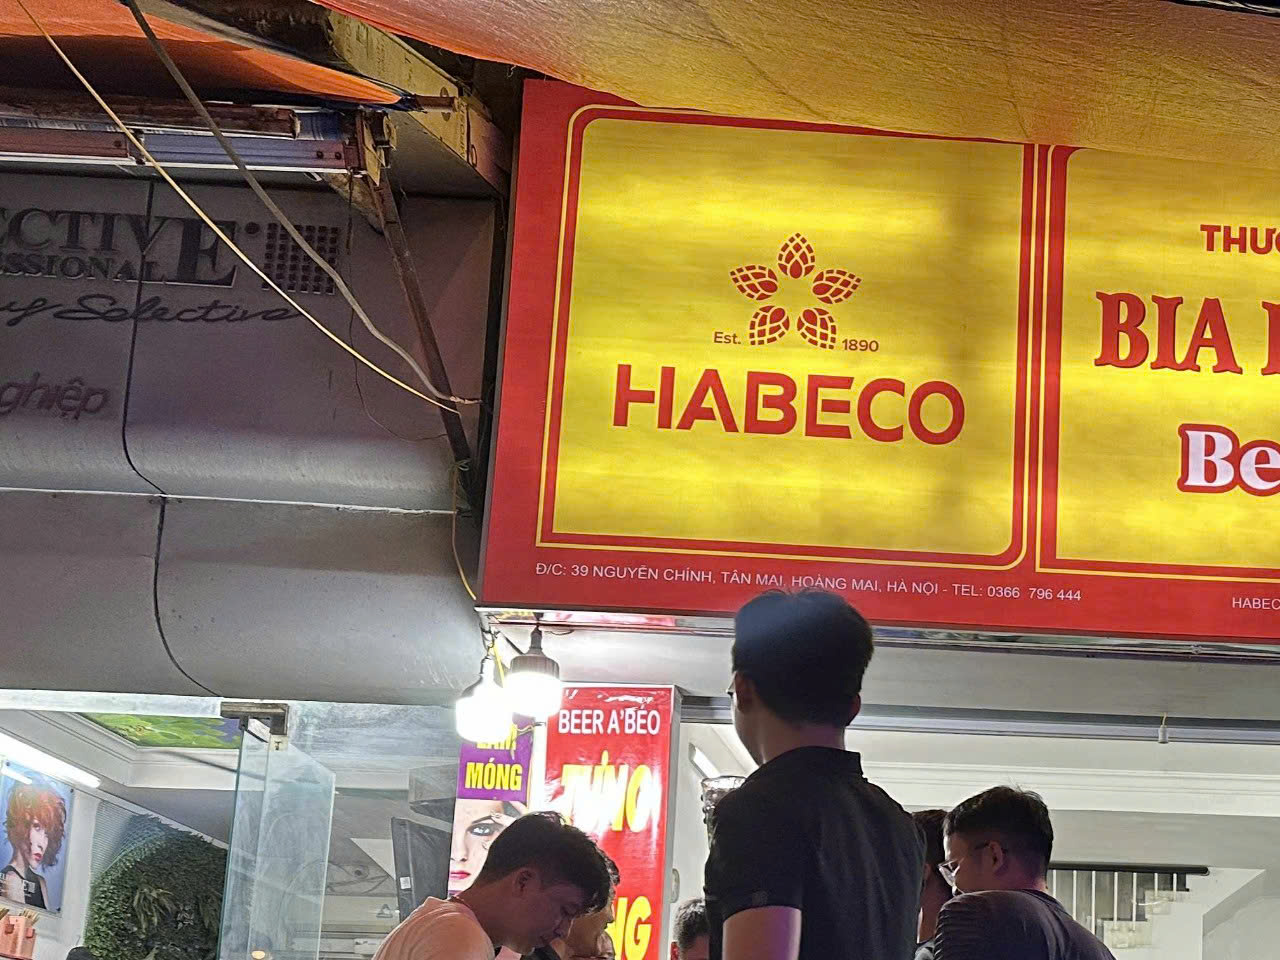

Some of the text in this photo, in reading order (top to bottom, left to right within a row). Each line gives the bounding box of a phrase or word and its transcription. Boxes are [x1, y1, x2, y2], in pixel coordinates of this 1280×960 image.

[0, 207, 237, 288] CTIVE
[0, 252, 164, 285] SSIONAL
[713, 331, 879, 352] Est. 1890
[1094, 291, 1243, 375] BIA
[612, 363, 965, 446] HABECO
[536, 563, 566, 576] Đ/C:
[571, 564, 588, 577] 39
[664, 567, 716, 584] CHÍNH,
[721, 570, 751, 585] TÂN
[791, 574, 847, 590] HOÀNG
[852, 579, 882, 593] MAI,
[887, 578, 908, 593] HÀ
[952, 584, 982, 597] TEL:
[987, 586, 1020, 598] 0366
[1029, 588, 1053, 600] 796
[1057, 589, 1081, 601] 444
[558, 709, 604, 734] BEER
[465, 758, 523, 791] MÓNG
